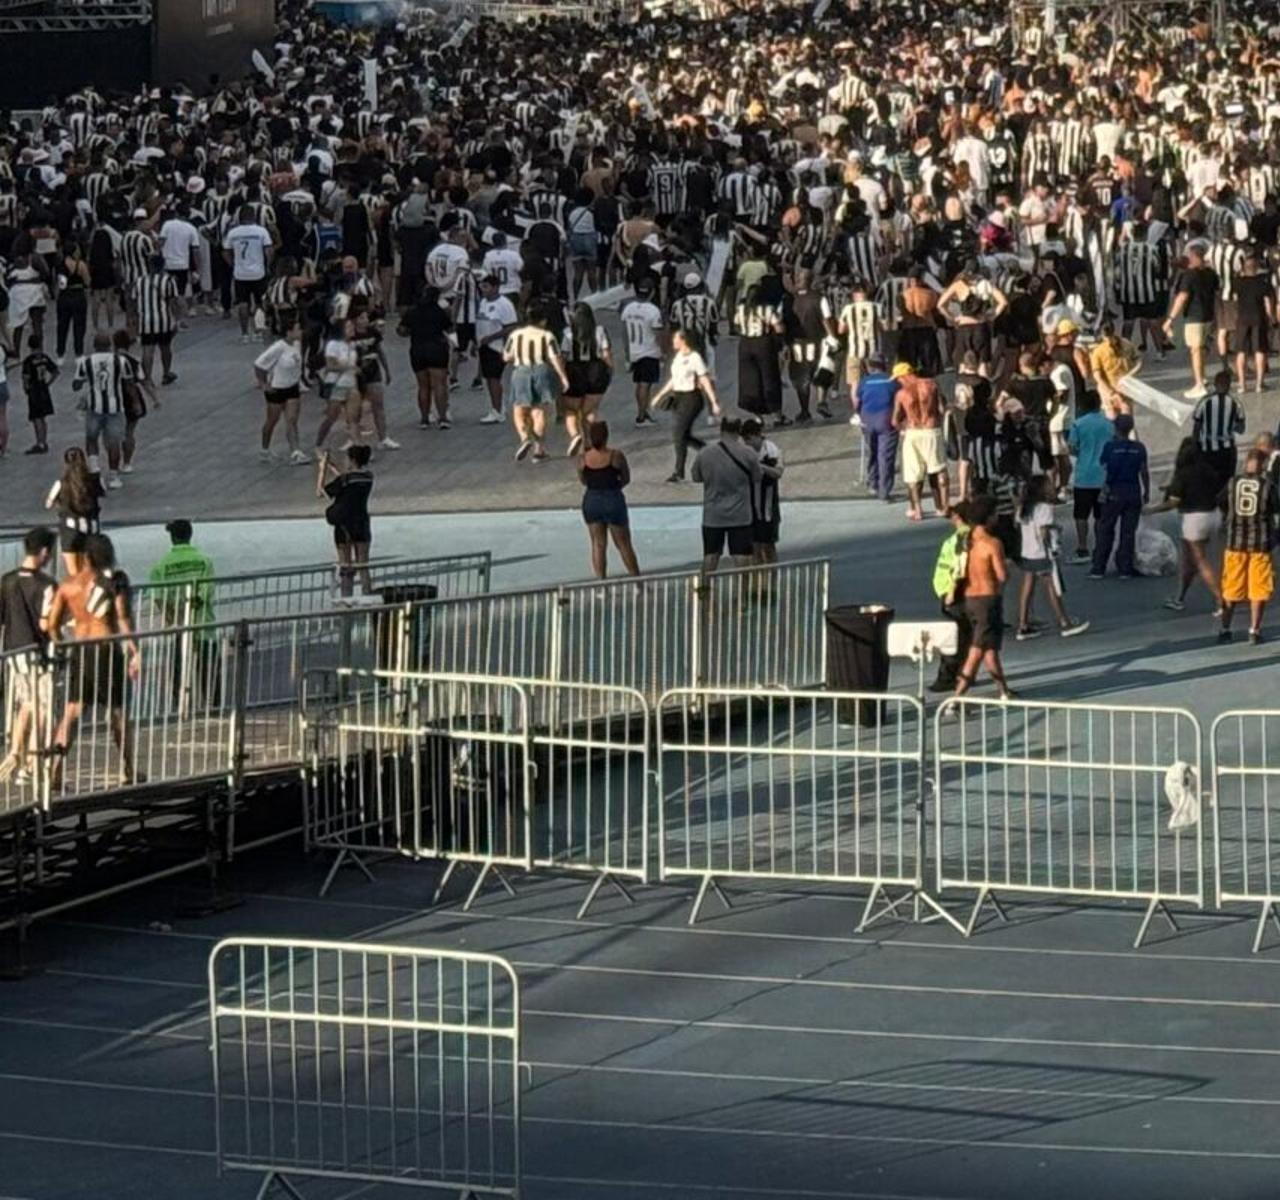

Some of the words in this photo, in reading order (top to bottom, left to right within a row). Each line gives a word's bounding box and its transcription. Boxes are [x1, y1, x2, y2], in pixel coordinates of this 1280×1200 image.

[660, 174, 671, 192] 9
[1096, 187, 1112, 206] 10
[240, 240, 249, 260] 7
[630, 321, 643, 346] 11
[1235, 478, 1260, 517] 6
